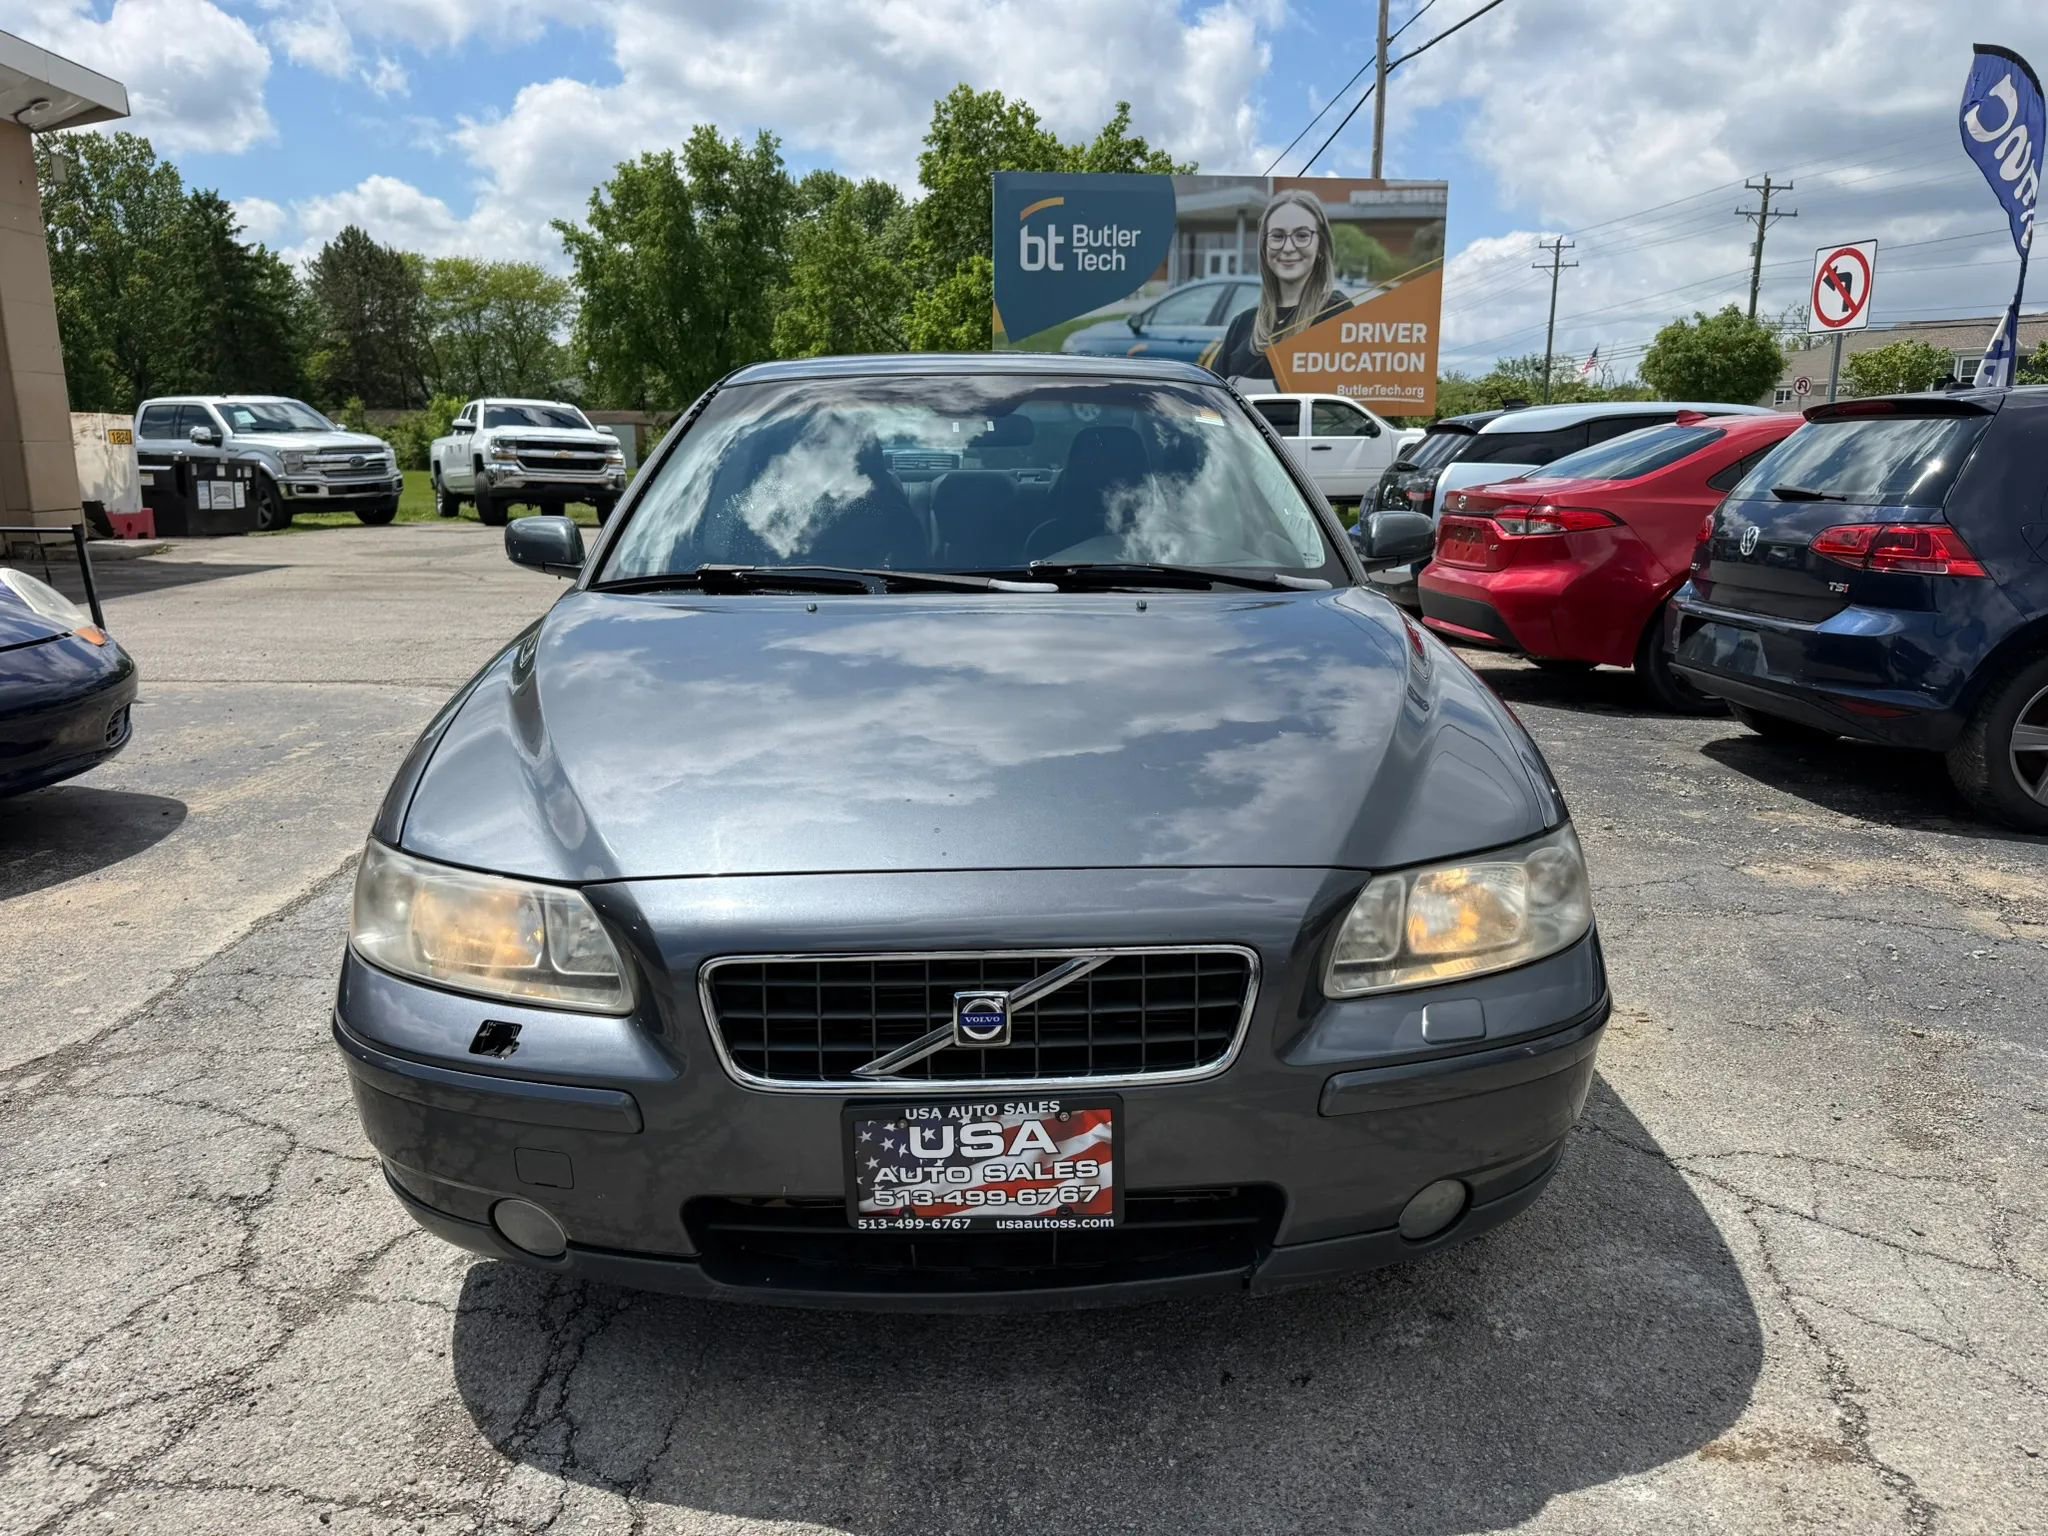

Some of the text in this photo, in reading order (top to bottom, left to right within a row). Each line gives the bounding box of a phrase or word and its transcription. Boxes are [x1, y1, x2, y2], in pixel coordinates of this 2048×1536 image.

[1072, 224, 1141, 247] Butler
[1020, 224, 1064, 271] bt
[1072, 248, 1126, 271] Tech
[1340, 322, 1427, 344] DRIVER
[1292, 352, 1425, 373] EDUCATION
[1337, 384, 1425, 398] ButlerTech.org
[905, 1101, 1061, 1120] USA AUTO SALES
[908, 1119, 1062, 1160] USA
[873, 1159, 1101, 1184] AUTO SALES
[873, 1185, 1101, 1207] 513-499-6767
[858, 1217, 1115, 1230] 513-499-6767 usaautoss.com
